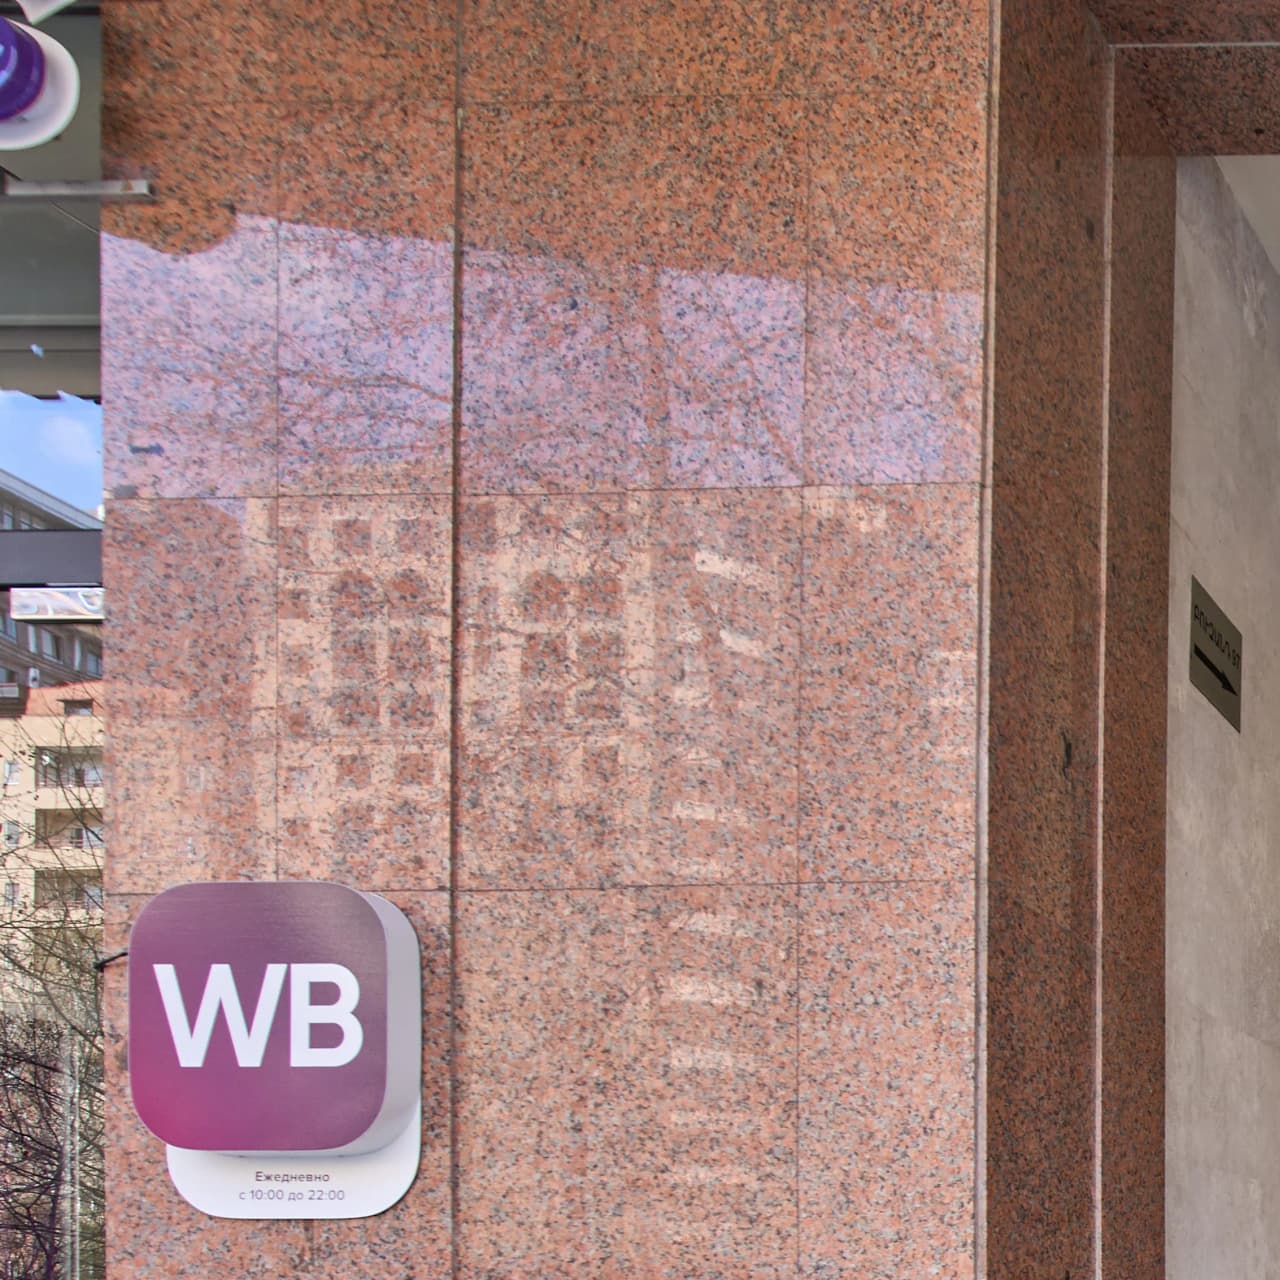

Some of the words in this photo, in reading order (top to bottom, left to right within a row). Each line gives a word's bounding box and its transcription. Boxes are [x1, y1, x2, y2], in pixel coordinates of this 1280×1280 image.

[153, 962, 364, 1068] WB
[255, 1171, 331, 1184] Ежедневно
[250, 1190, 284, 1200] 10:00
[287, 1191, 304, 1202] до
[307, 1190, 345, 1200] 22:00
